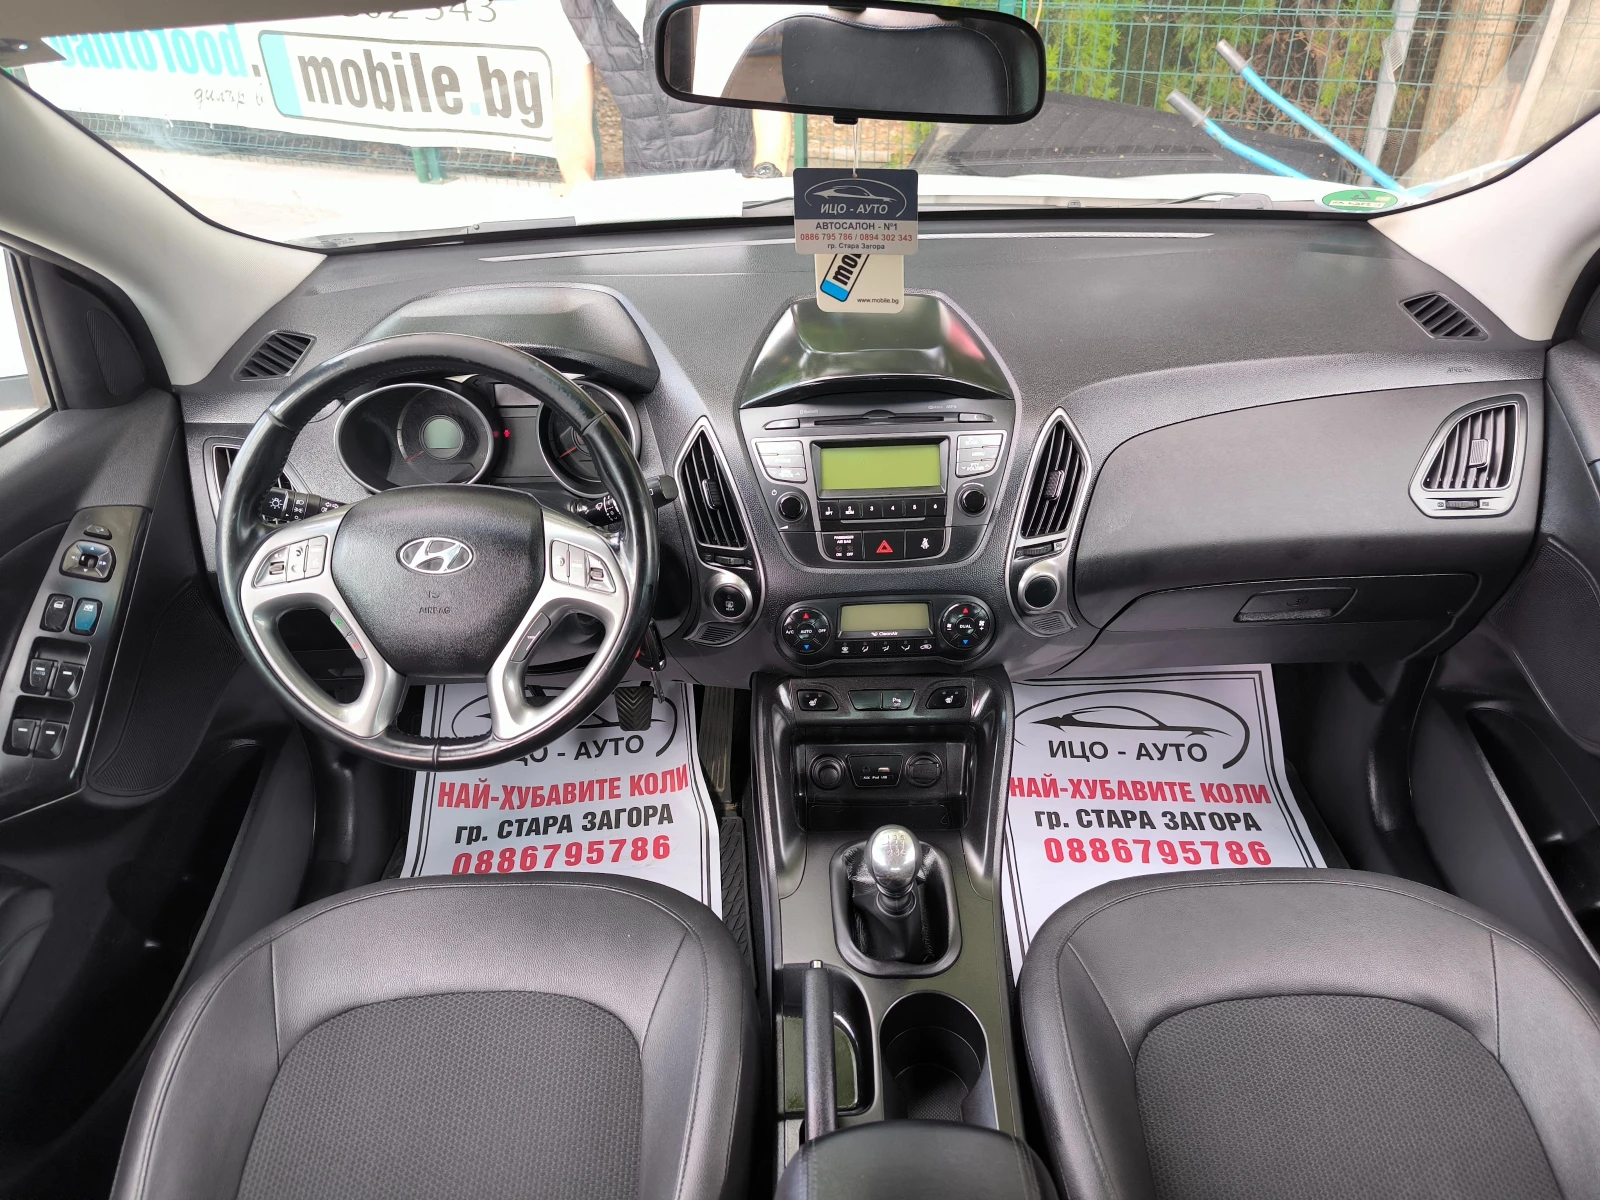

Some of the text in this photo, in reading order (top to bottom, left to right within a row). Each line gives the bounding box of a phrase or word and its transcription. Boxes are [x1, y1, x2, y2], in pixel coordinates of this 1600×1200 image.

[298, 49, 543, 128] mobile.bg
[820, 204, 847, 216] ИЦО
[856, 205, 888, 215] АУТО
[800, 233, 820, 241] 0886
[822, 233, 836, 241] 795
[838, 233, 853, 241] 786
[859, 233, 879, 241] 0894
[881, 234, 896, 242] 302
[898, 234, 913, 242] 343
[815, 221, 875, 231] АВТОСАЛОН
[861, 243, 885, 251] Загора
[856, 297, 900, 305] www.mobile.bg
[574, 735, 644, 761] АУТО
[1048, 740, 1108, 762] ИЦО
[1136, 742, 1208, 763] АУТО
[437, 764, 689, 810] НАЙ-ХУБАВИТЕ КОЛИ
[1010, 773, 1272, 804] НАЙ-ХУБАВИТЕ КОЛИ
[455, 803, 674, 845] гр. СТАРА ЗАГОРА
[1034, 808, 1263, 832] гр. СТАРА ЗАГОРА
[451, 834, 671, 875] 0886795786
[1043, 837, 1272, 866] 0886795786
